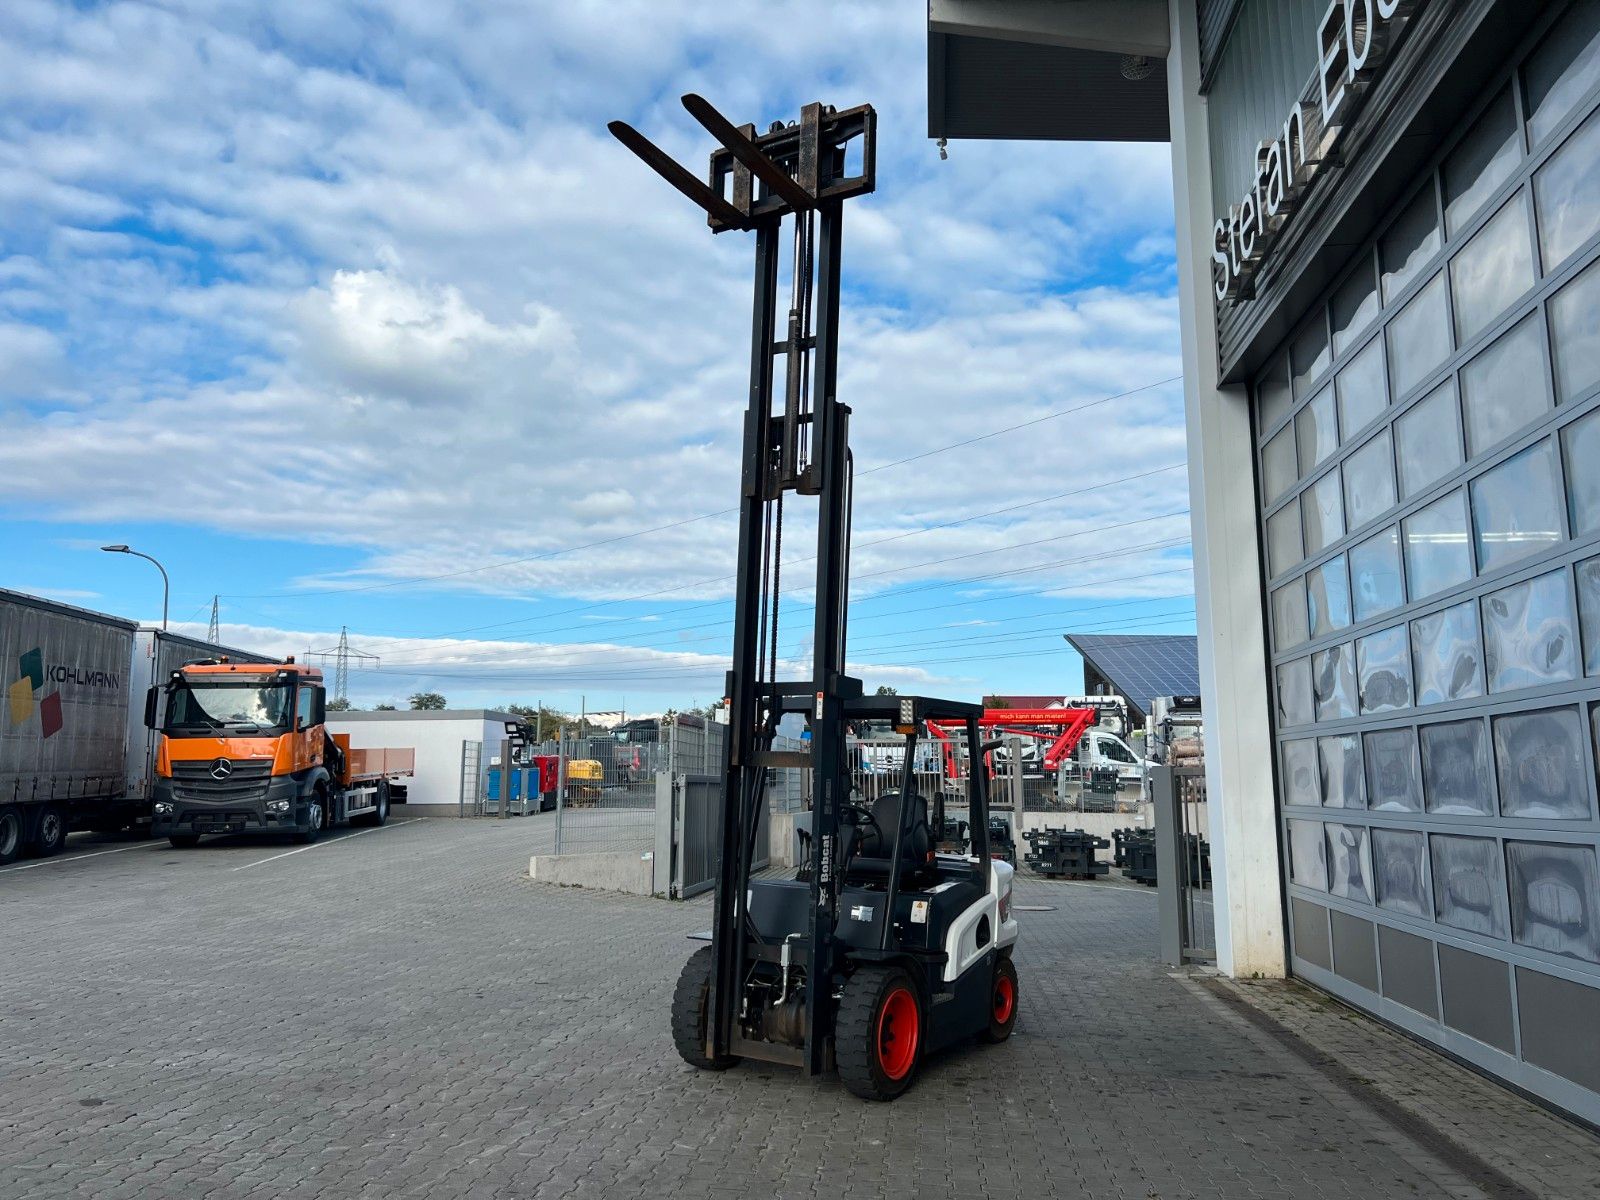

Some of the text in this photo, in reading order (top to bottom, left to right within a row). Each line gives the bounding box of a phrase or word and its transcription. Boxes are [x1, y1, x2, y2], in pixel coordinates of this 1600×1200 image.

[1213, 101, 1306, 300] Stefan
[46, 665, 119, 689] KOHLMANN
[820, 835, 830, 882] Bobcat
